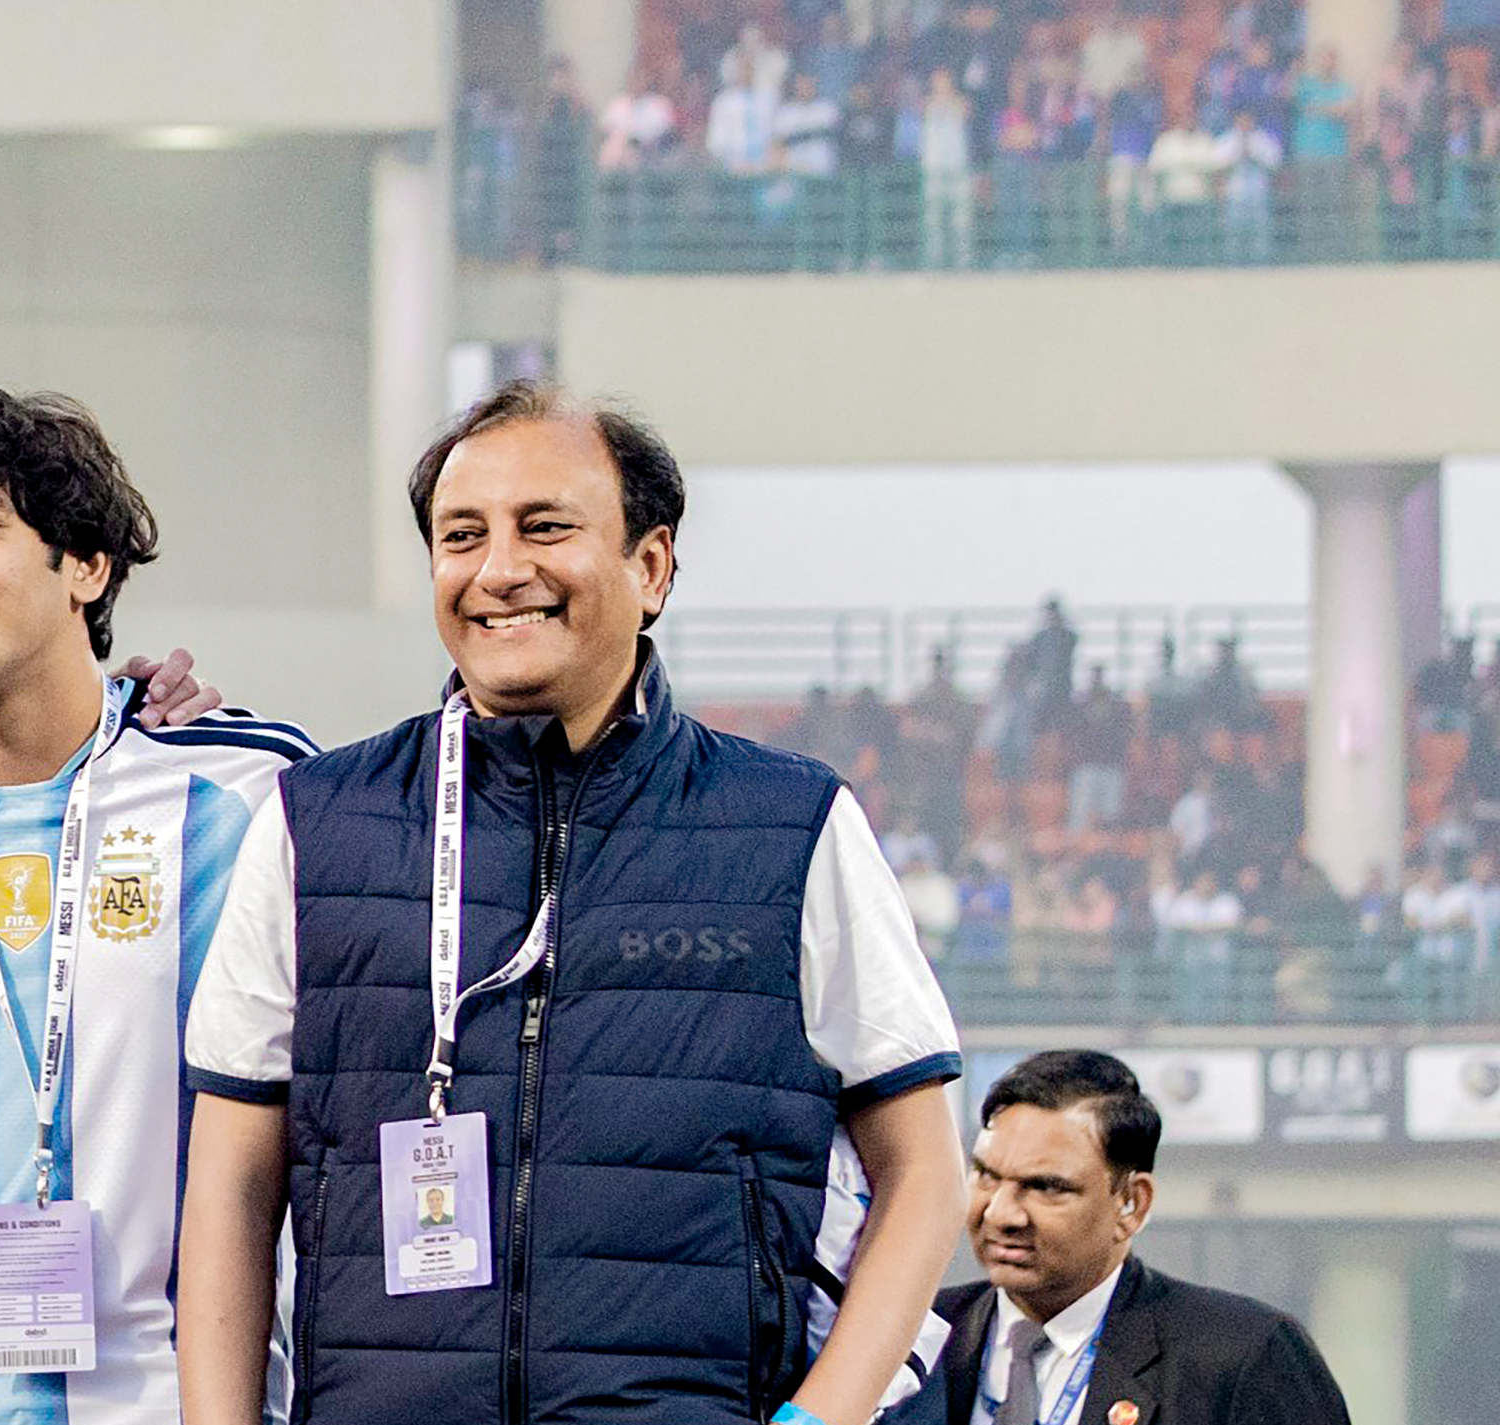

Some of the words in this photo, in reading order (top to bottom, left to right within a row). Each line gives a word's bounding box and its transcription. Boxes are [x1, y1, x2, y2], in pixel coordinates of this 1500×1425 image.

[444, 781, 458, 815] MESSI
[103, 876, 146, 916] AFA
[5, 914, 34, 927] FIFA
[59, 901, 74, 937] MESSI
[439, 929, 450, 961] district
[619, 927, 752, 962] BOSS
[55, 958, 66, 993] district
[413, 1145, 455, 1162] G.O.A.T
[12, 1221, 17, 1229] &
[19, 1220, 61, 1230] CONDITIONS
